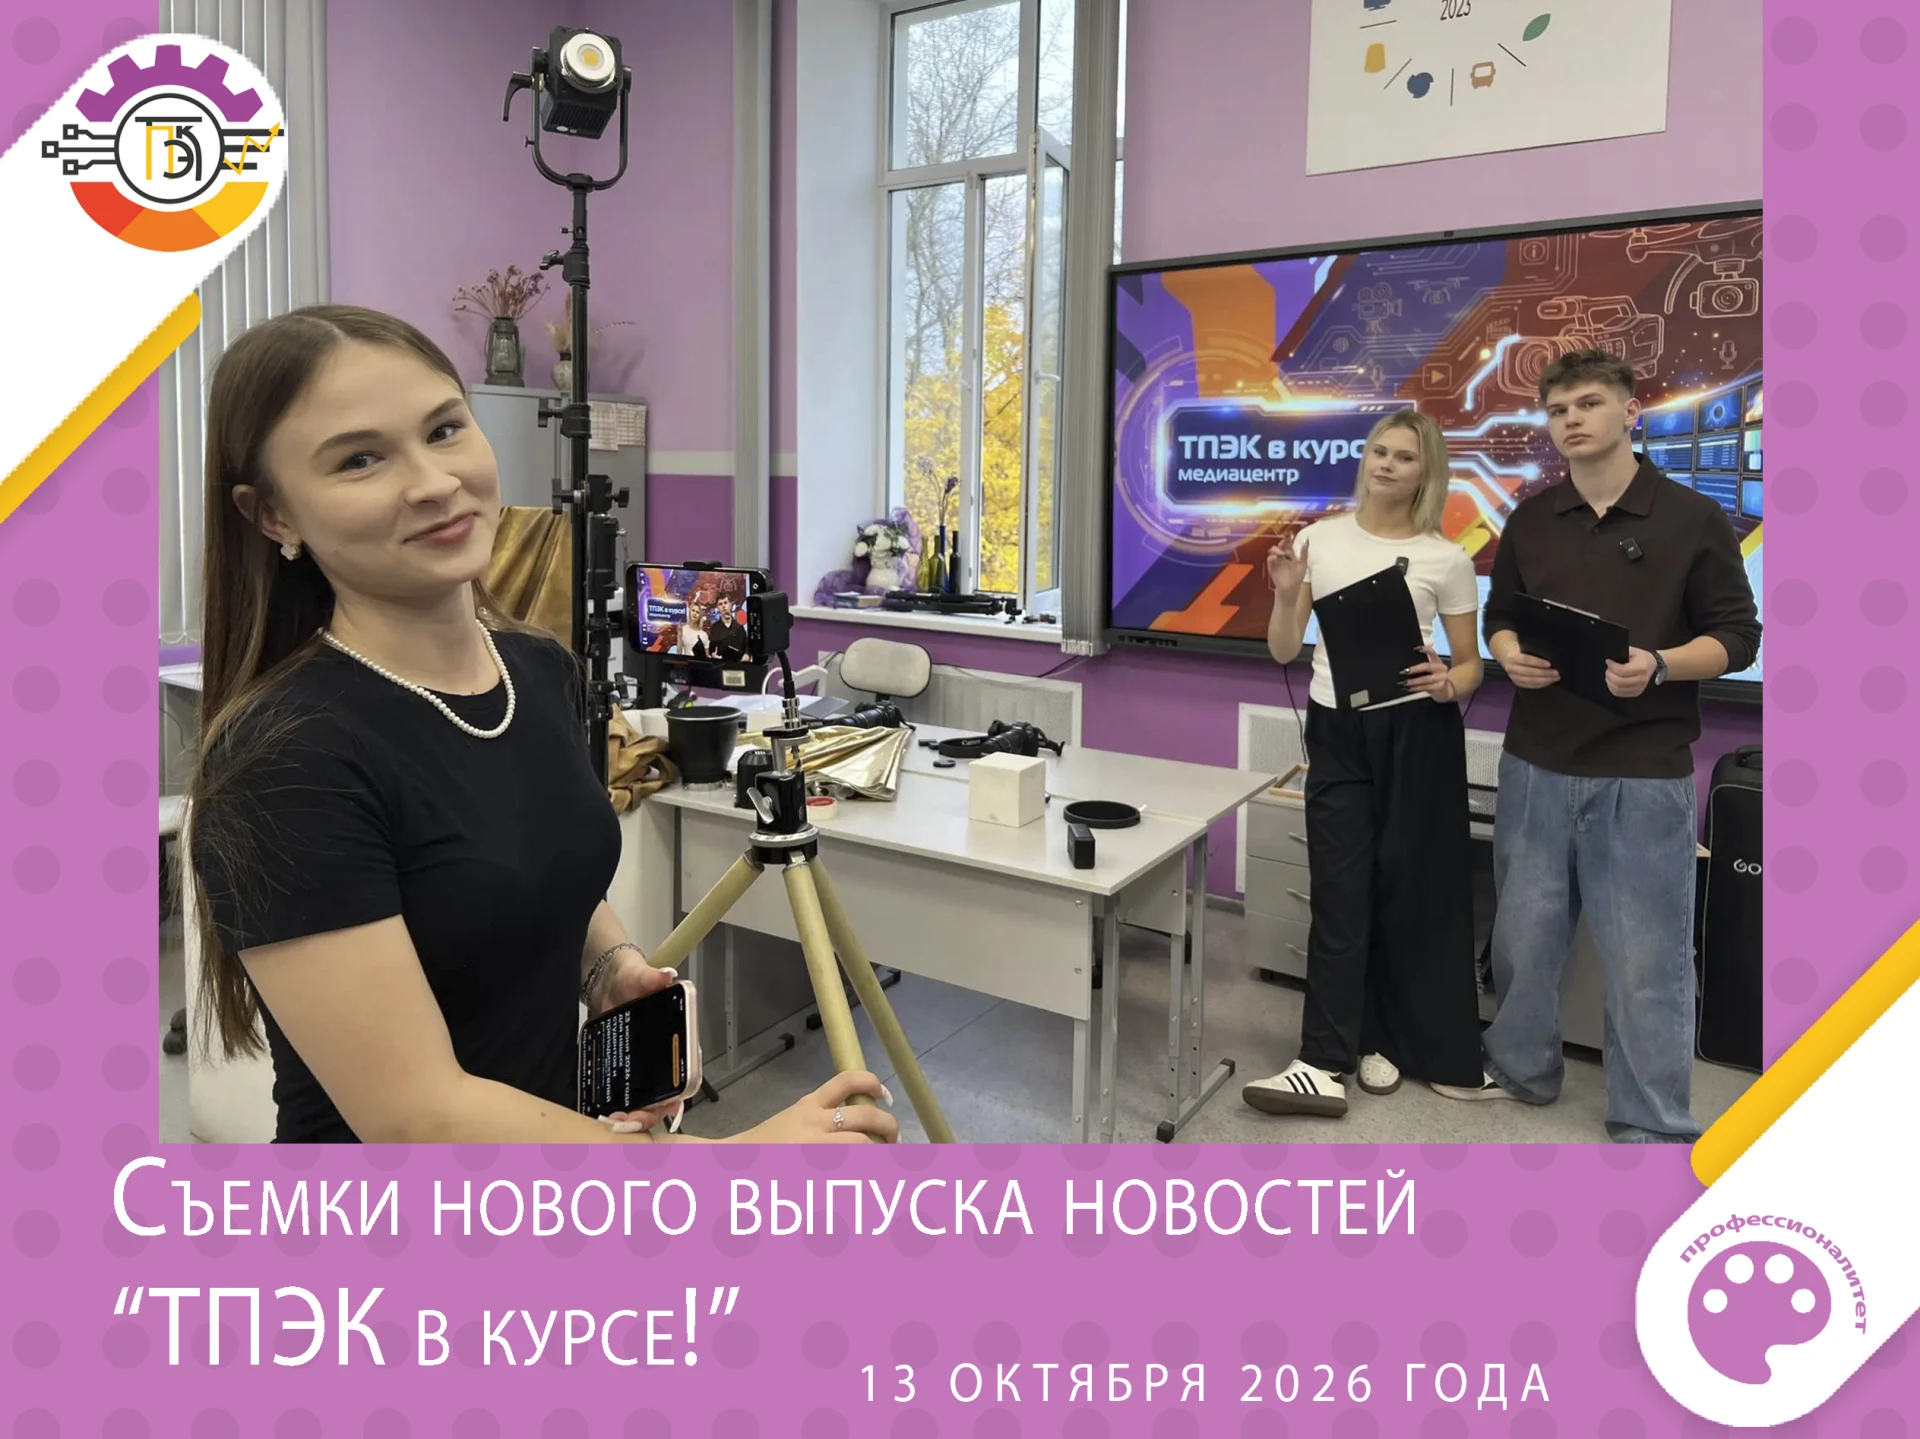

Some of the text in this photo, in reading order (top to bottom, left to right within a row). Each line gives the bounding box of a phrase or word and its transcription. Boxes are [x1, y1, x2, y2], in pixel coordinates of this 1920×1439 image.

[1440, 0, 1471, 20] 2023
[1178, 434, 1367, 465] ТПЭК в курс
[1178, 468, 1300, 485] медиацентр
